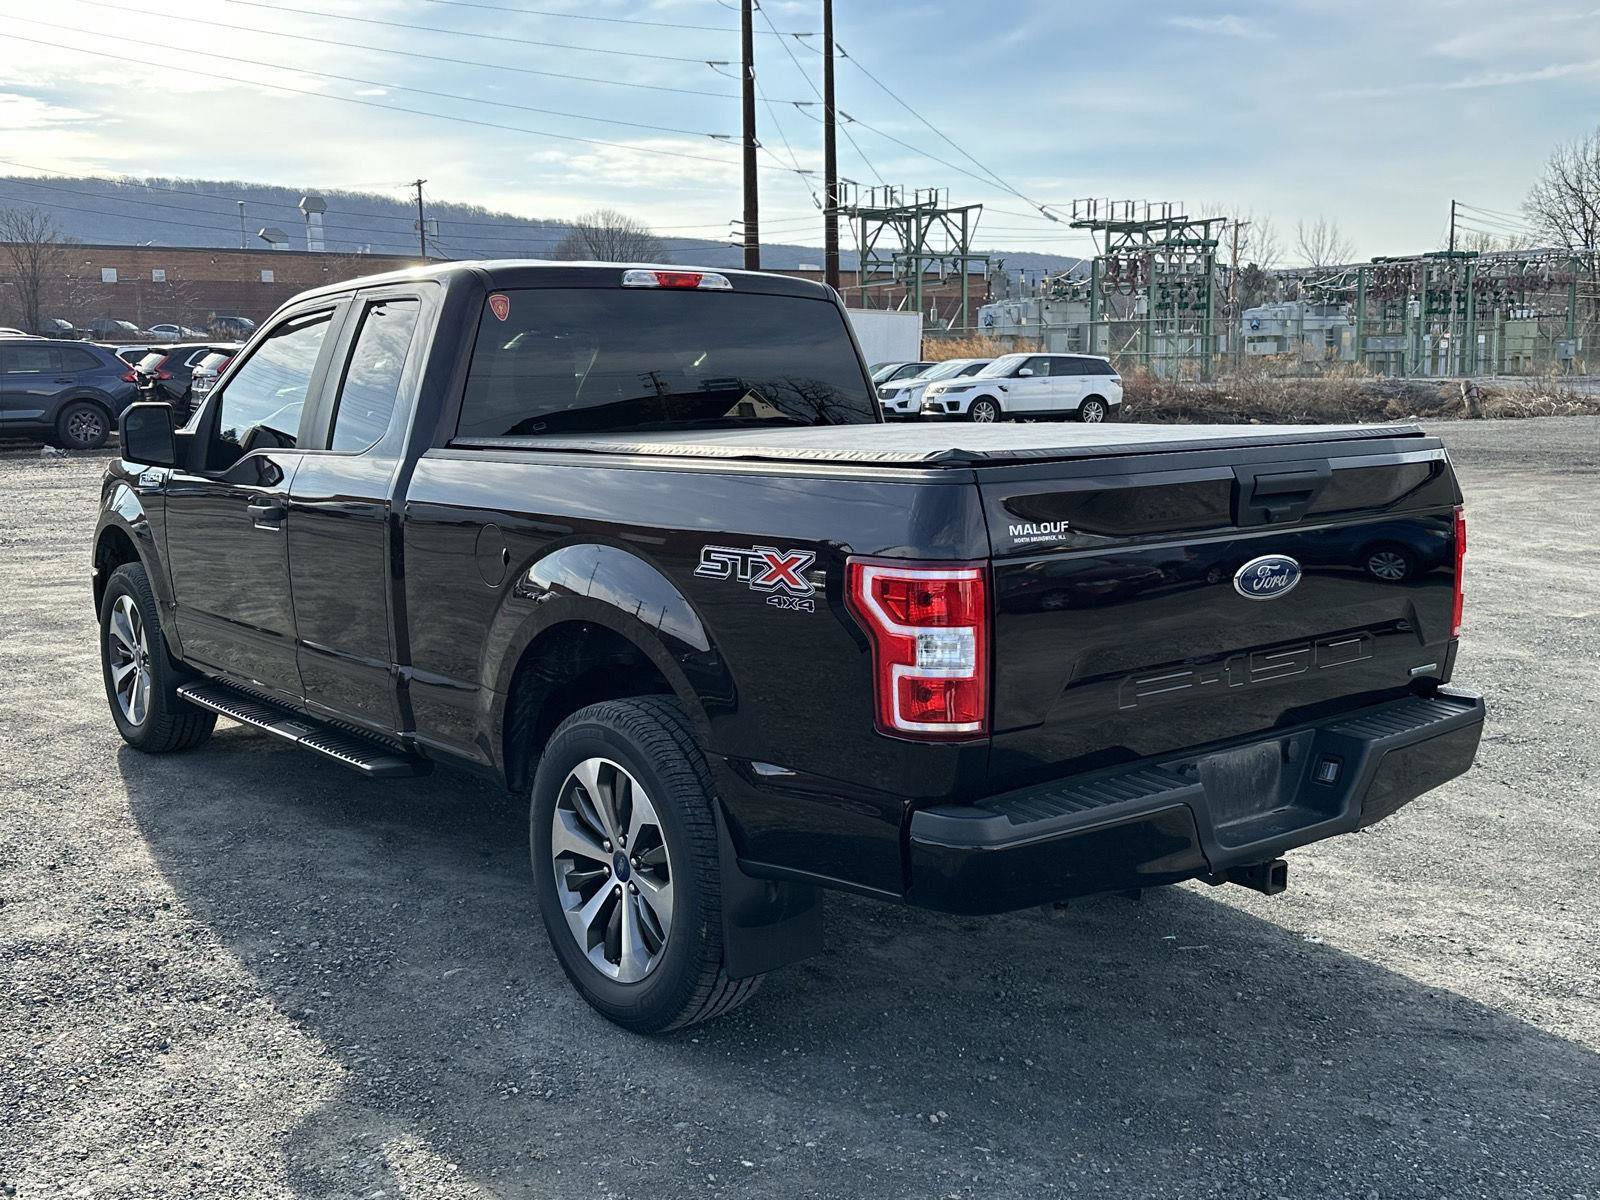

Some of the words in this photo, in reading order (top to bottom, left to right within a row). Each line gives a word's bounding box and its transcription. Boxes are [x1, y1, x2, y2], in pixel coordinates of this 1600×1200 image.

[1009, 521, 1069, 536] MALOUF
[693, 545, 817, 597] STX
[1253, 565, 1290, 591] Ford
[1118, 631, 1376, 710] F-150
